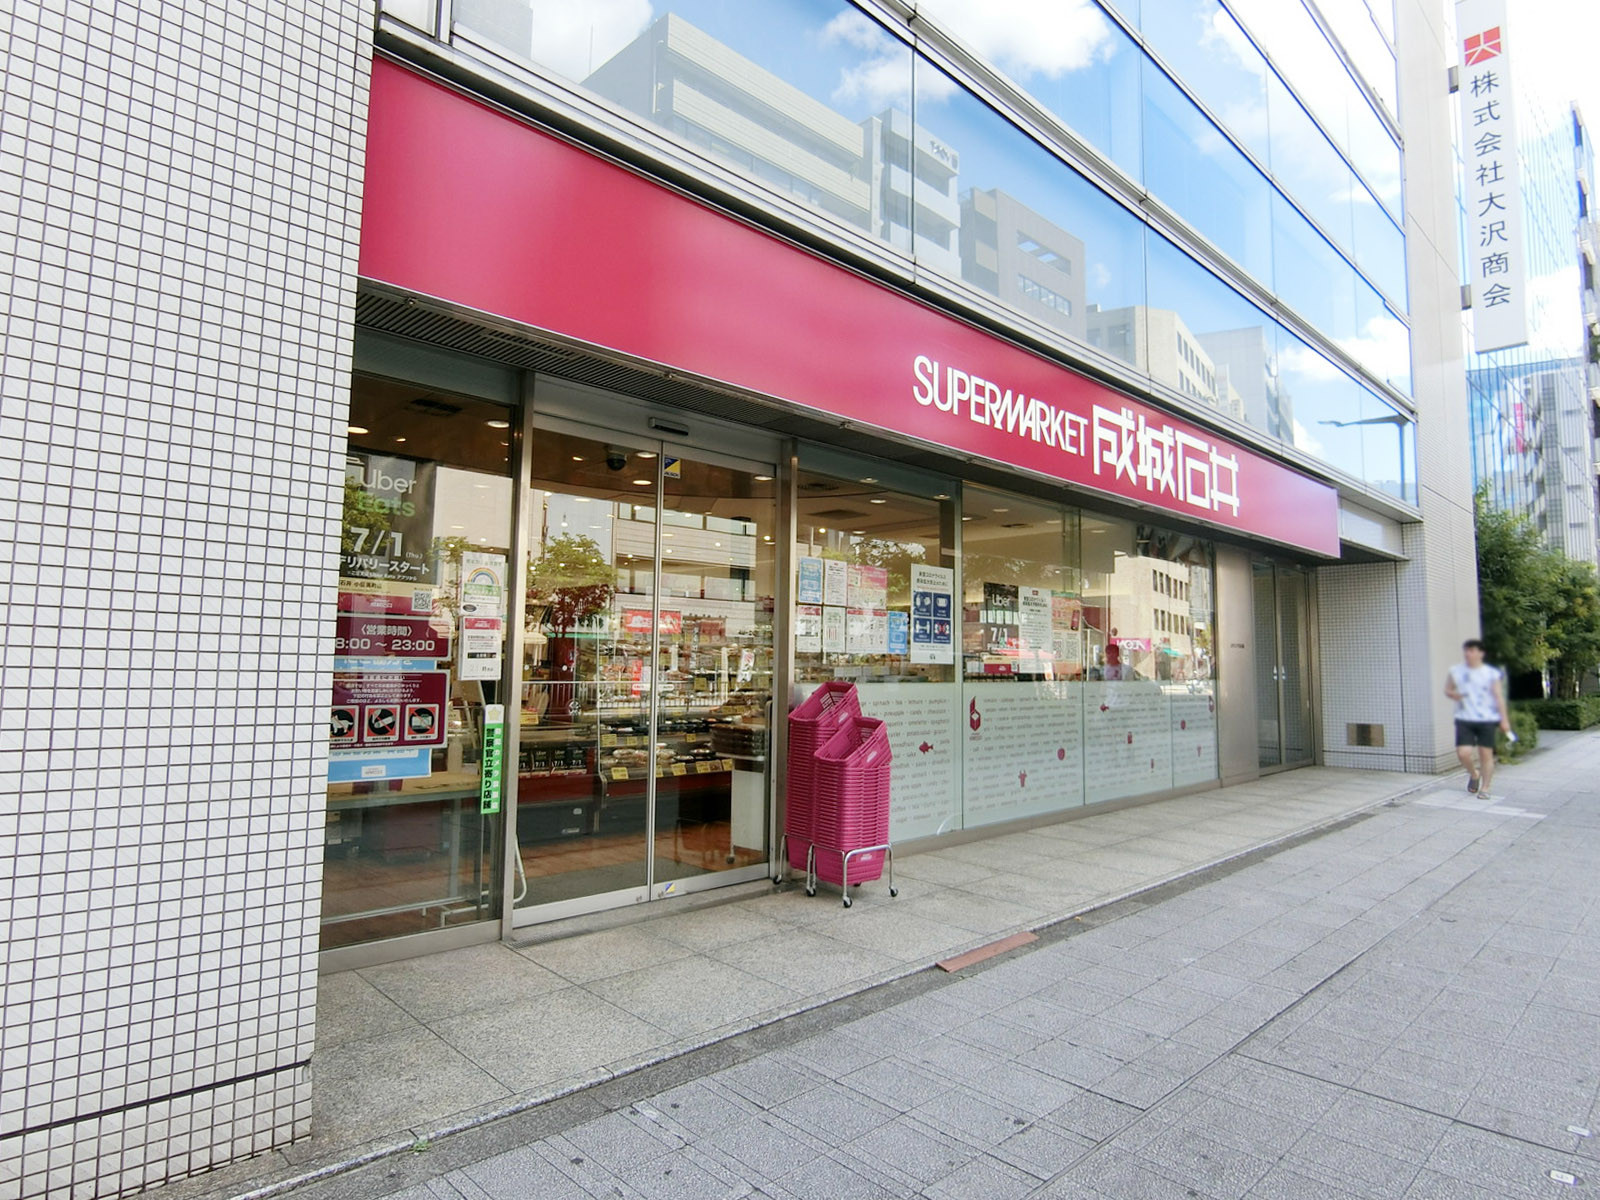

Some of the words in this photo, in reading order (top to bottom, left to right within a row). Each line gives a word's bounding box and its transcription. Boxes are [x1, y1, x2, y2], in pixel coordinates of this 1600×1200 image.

[1470, 69, 1512, 309] 株式会社大沢商会
[912, 354, 1089, 457] SUPERMARKET
[1092, 402, 1241, 517] 成城石井
[359, 467, 418, 494] Uber
[358, 489, 416, 517] Eats
[350, 526, 403, 557] 7/1
[335, 637, 371, 649] 8:00
[391, 639, 435, 651] 23:00
